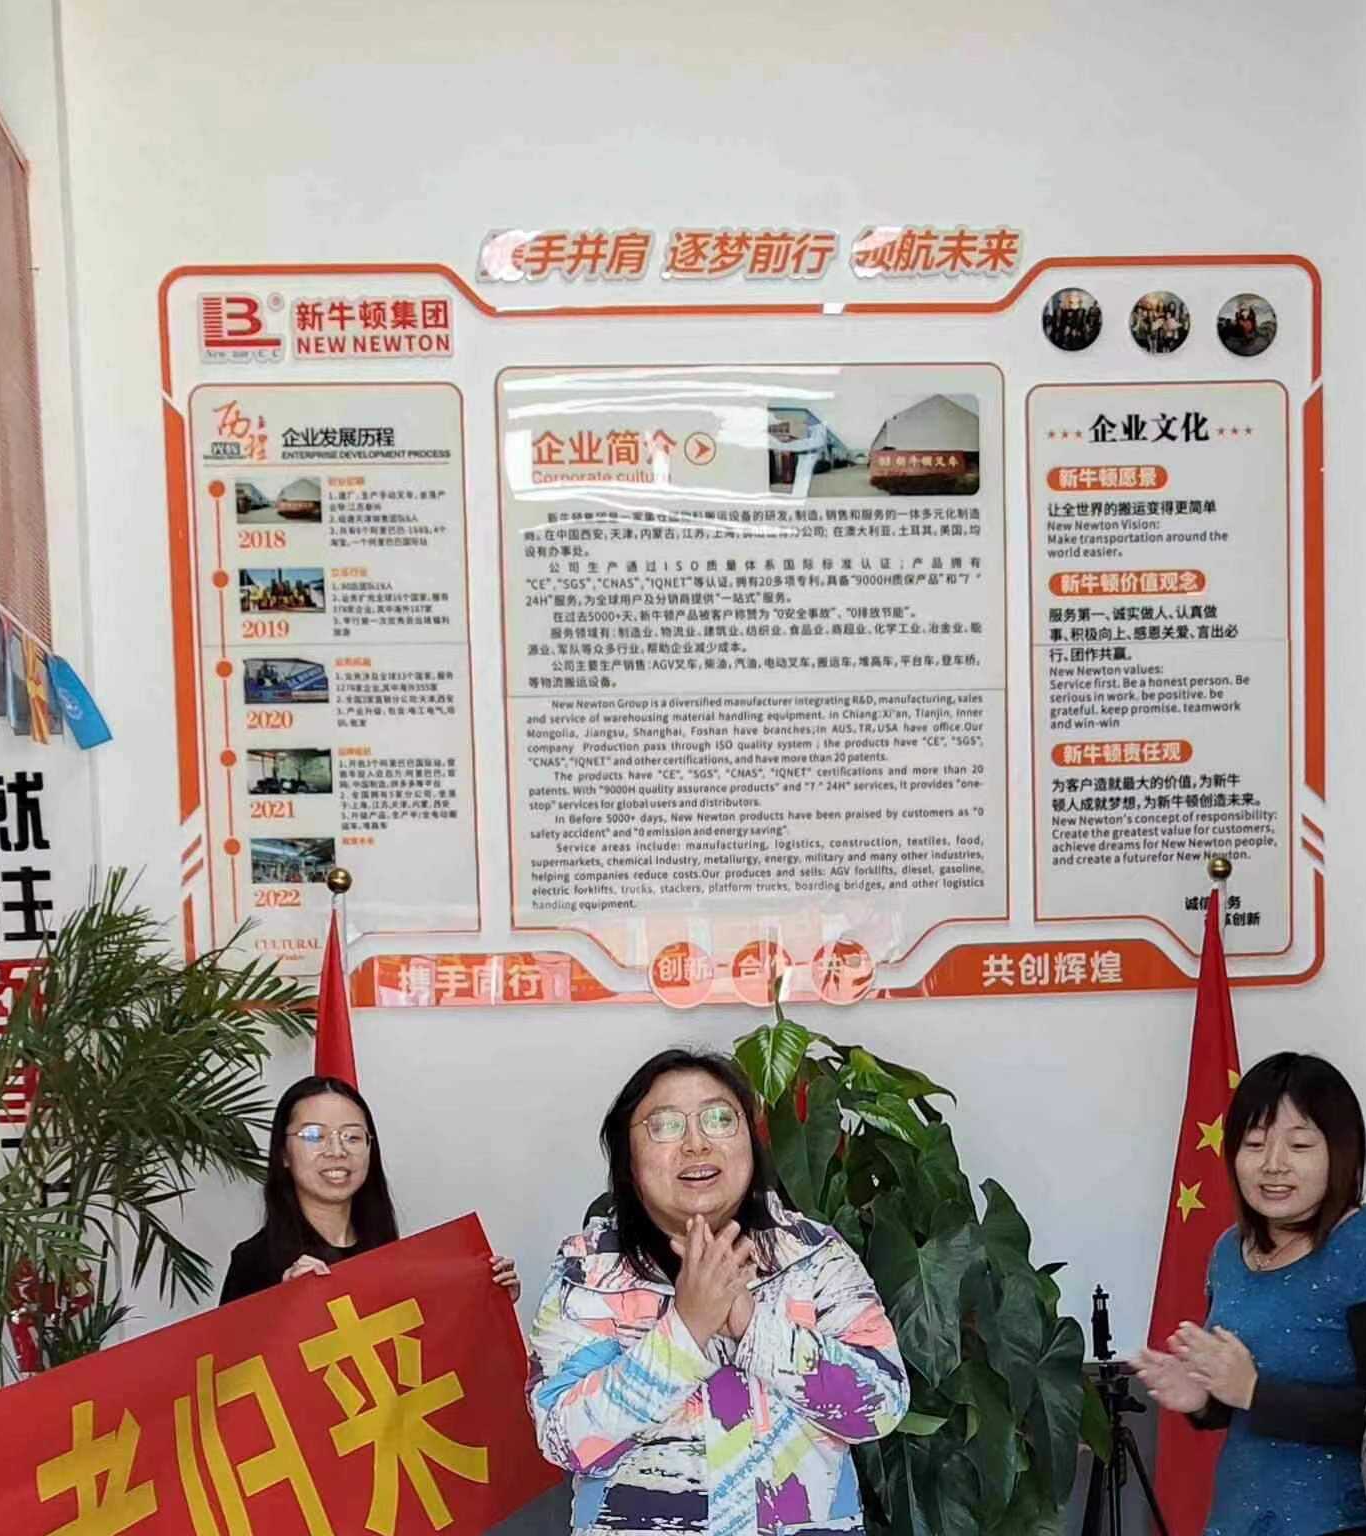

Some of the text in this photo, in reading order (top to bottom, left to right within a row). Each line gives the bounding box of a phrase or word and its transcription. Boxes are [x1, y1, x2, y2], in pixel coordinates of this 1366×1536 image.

[480, 230, 650, 276] 手并肩
[667, 231, 835, 274] 逐梦前行
[296, 300, 449, 331] 新牛顿集团
[297, 334, 450, 353] NEW NEWTON
[1088, 412, 1210, 443] 企业文化
[282, 427, 395, 447] 企业发展历程
[282, 450, 451, 460] ENTERPRISE DEVELOPMENT PROCESS
[1058, 466, 1157, 489] 新牛顿愿景
[1047, 500, 1217, 517] 让全世界的搬运变得更简单
[1047, 519, 1160, 531] New Newton Vision:
[238, 530, 286, 549] 2018
[1047, 531, 1228, 546] Make transportation around the
[1047, 548, 1080, 559] world
[1061, 572, 1199, 594] 新牛顿价值观念
[243, 620, 289, 639] 2019
[1049, 664, 1164, 676] New Newton values:
[1049, 679, 1092, 690] Service
[1122, 678, 1137, 688] Be
[1139, 680, 1146, 688] a
[1148, 677, 1187, 688] honest
[1235, 675, 1250, 685] Be
[552, 700, 573, 709] New
[576, 700, 615, 709] Newton
[617, 699, 649, 710] Group
[651, 699, 659, 708] is
[669, 698, 722, 708] diversified
[724, 696, 792, 707] manufacturer
[795, 696, 850, 708] integrating
[957, 694, 983, 704] sales
[1049, 692, 1092, 703] serious
[1094, 692, 1104, 702] in
[1141, 690, 1156, 700] be
[1209, 688, 1224, 699] be
[526, 711, 763, 724] and service of warehousing material handling
[1100, 705, 1129, 718] keep
[1183, 701, 1241, 713] teamwork
[247, 711, 293, 729] 2020
[1050, 718, 1120, 730] and win-win
[1062, 743, 1181, 765] 新牛顿责任观
[251, 800, 296, 819] 2021
[1052, 810, 1278, 827] New Newton's concept of responsibility:
[1052, 824, 1275, 840] Create the greatest value for customers,
[1052, 836, 1278, 852] achieve dreams for New Newton people,
[1053, 855, 1073, 865] and
[1076, 854, 1112, 864] create
[1114, 855, 1121, 863] a
[1176, 851, 1201, 861] New
[531, 871, 668, 883] helping companies reduce
[254, 889, 301, 908] 2022
[982, 951, 1124, 987] 共创辉煌
